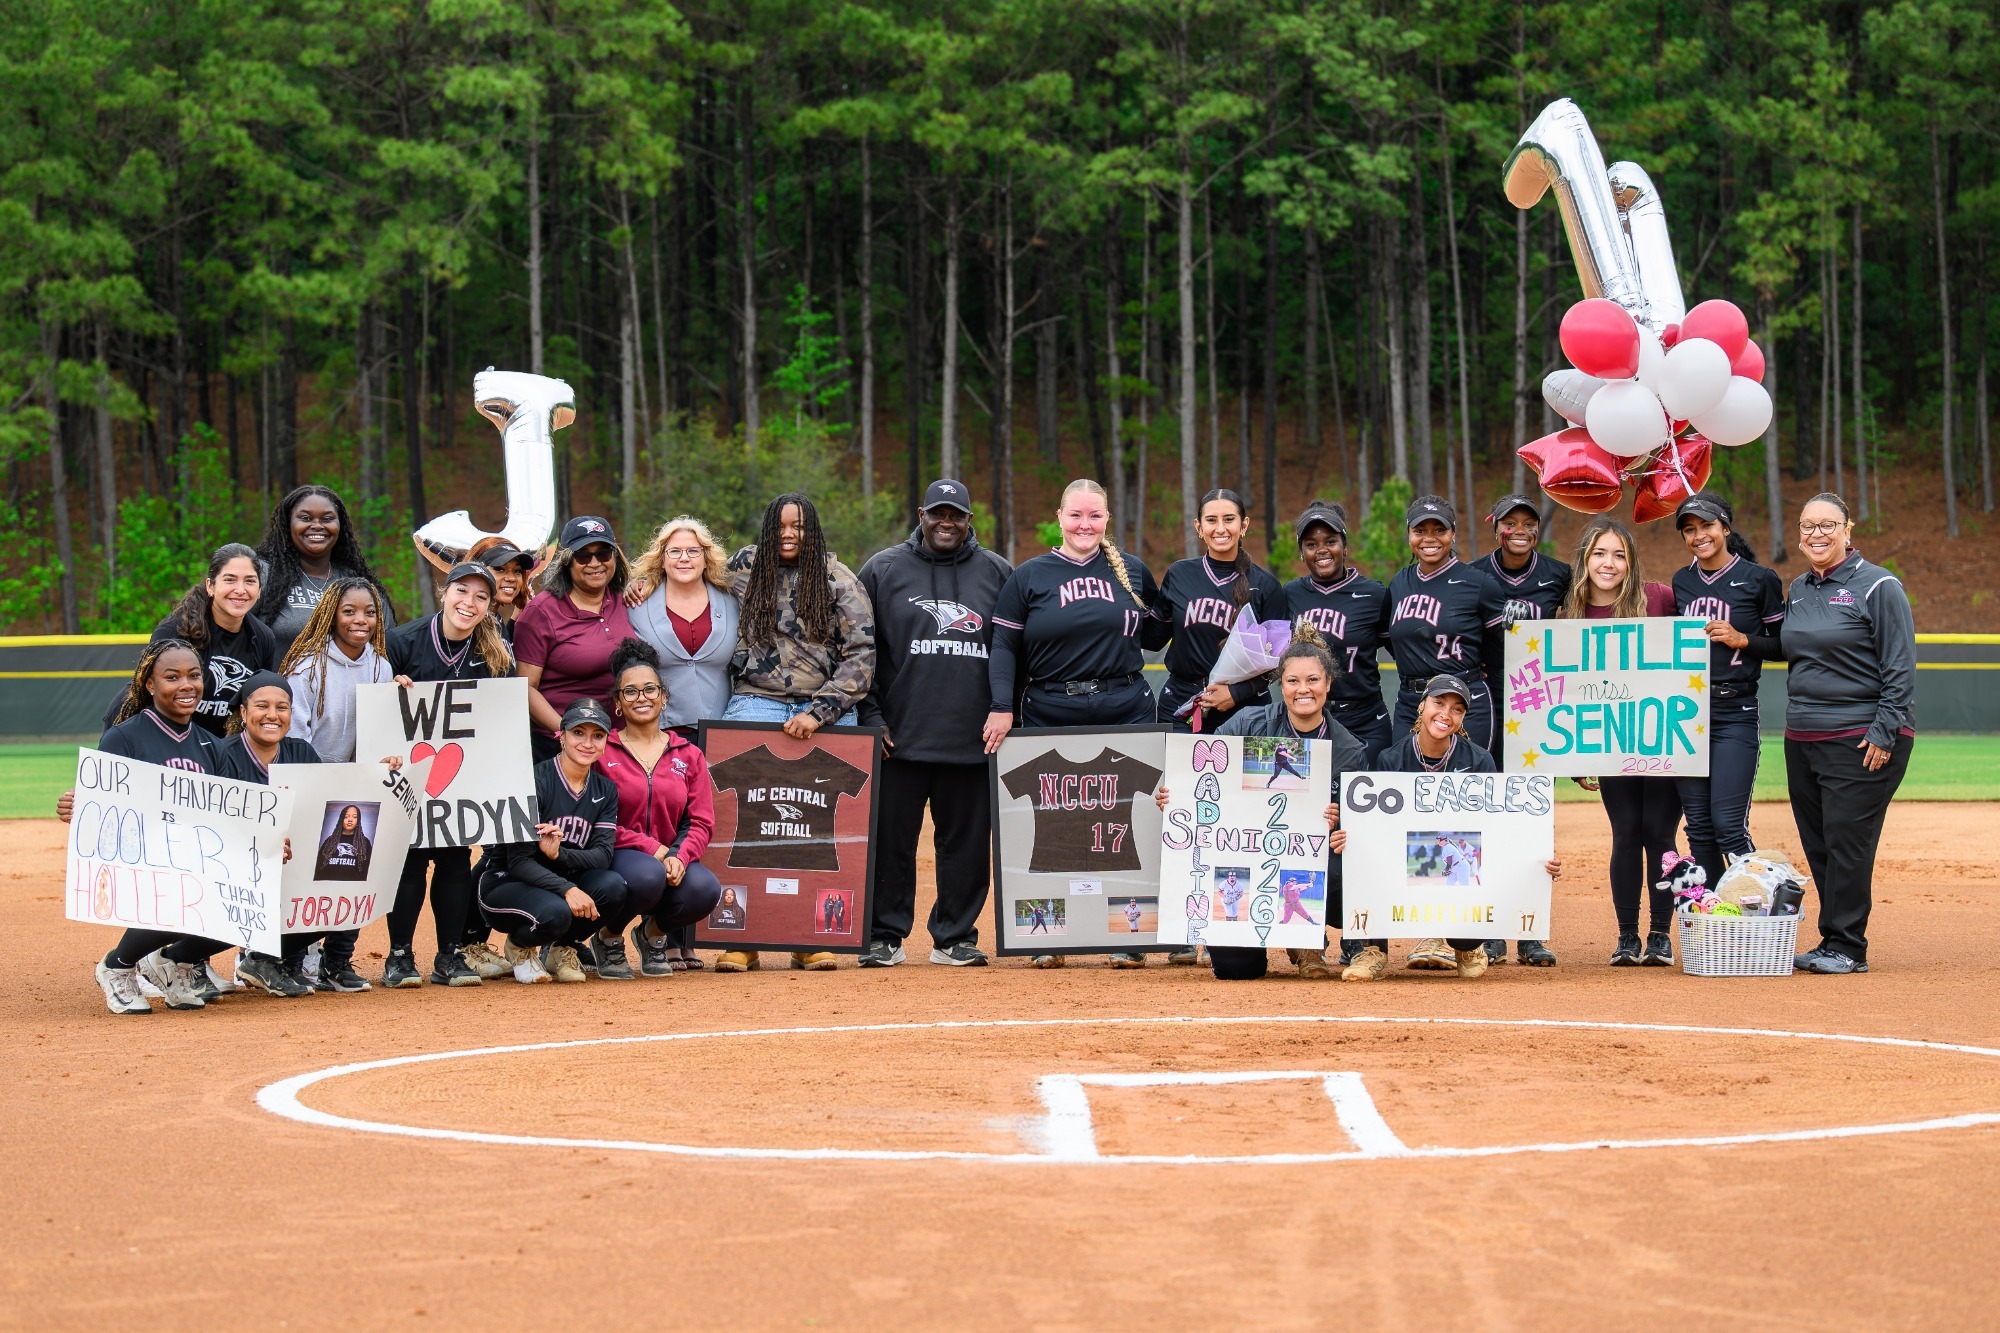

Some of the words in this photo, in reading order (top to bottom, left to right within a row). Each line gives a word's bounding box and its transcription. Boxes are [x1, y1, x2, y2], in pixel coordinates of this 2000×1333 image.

[1059, 576, 1115, 608] NCCU
[1122, 608, 1140, 637] 17
[1391, 593, 1442, 627] NCCU
[910, 639, 989, 659] SOFTBALL
[1346, 645, 1359, 674] 7
[1435, 633, 1464, 661] 24
[1544, 620, 1707, 673] LITTLE
[1509, 658, 1541, 691] MJ
[1509, 675, 1565, 714] #17
[1578, 680, 1634, 701] miss
[195, 699, 233, 717] OFTB
[397, 680, 478, 742] WE
[1539, 695, 1699, 756] SENIOR
[1621, 757, 1673, 773] 2026
[79, 756, 130, 796] OUR
[160, 773, 278, 827] MANAGER
[382, 769, 418, 820] SENIOR
[747, 788, 766, 803] NC
[769, 787, 828, 808] CENTRAL
[1038, 773, 1119, 811] NCCU
[1346, 775, 1405, 814] Go
[1414, 775, 1551, 816] EAGLES
[161, 811, 175, 823] IS
[409, 796, 541, 850] RDYN
[548, 815, 592, 849] CCU
[760, 821, 812, 838] SOFTBALL
[76, 801, 230, 879] COOLER
[1091, 822, 1129, 852] 17
[328, 857, 356, 866] SOFTBALL
[214, 881, 265, 908] THAN
[222, 902, 266, 931] YOURS
[286, 893, 377, 930] JORDYN
[1354, 913, 1369, 931] 17
[1392, 905, 1494, 923] MADELINE
[1520, 914, 1535, 932] 17
